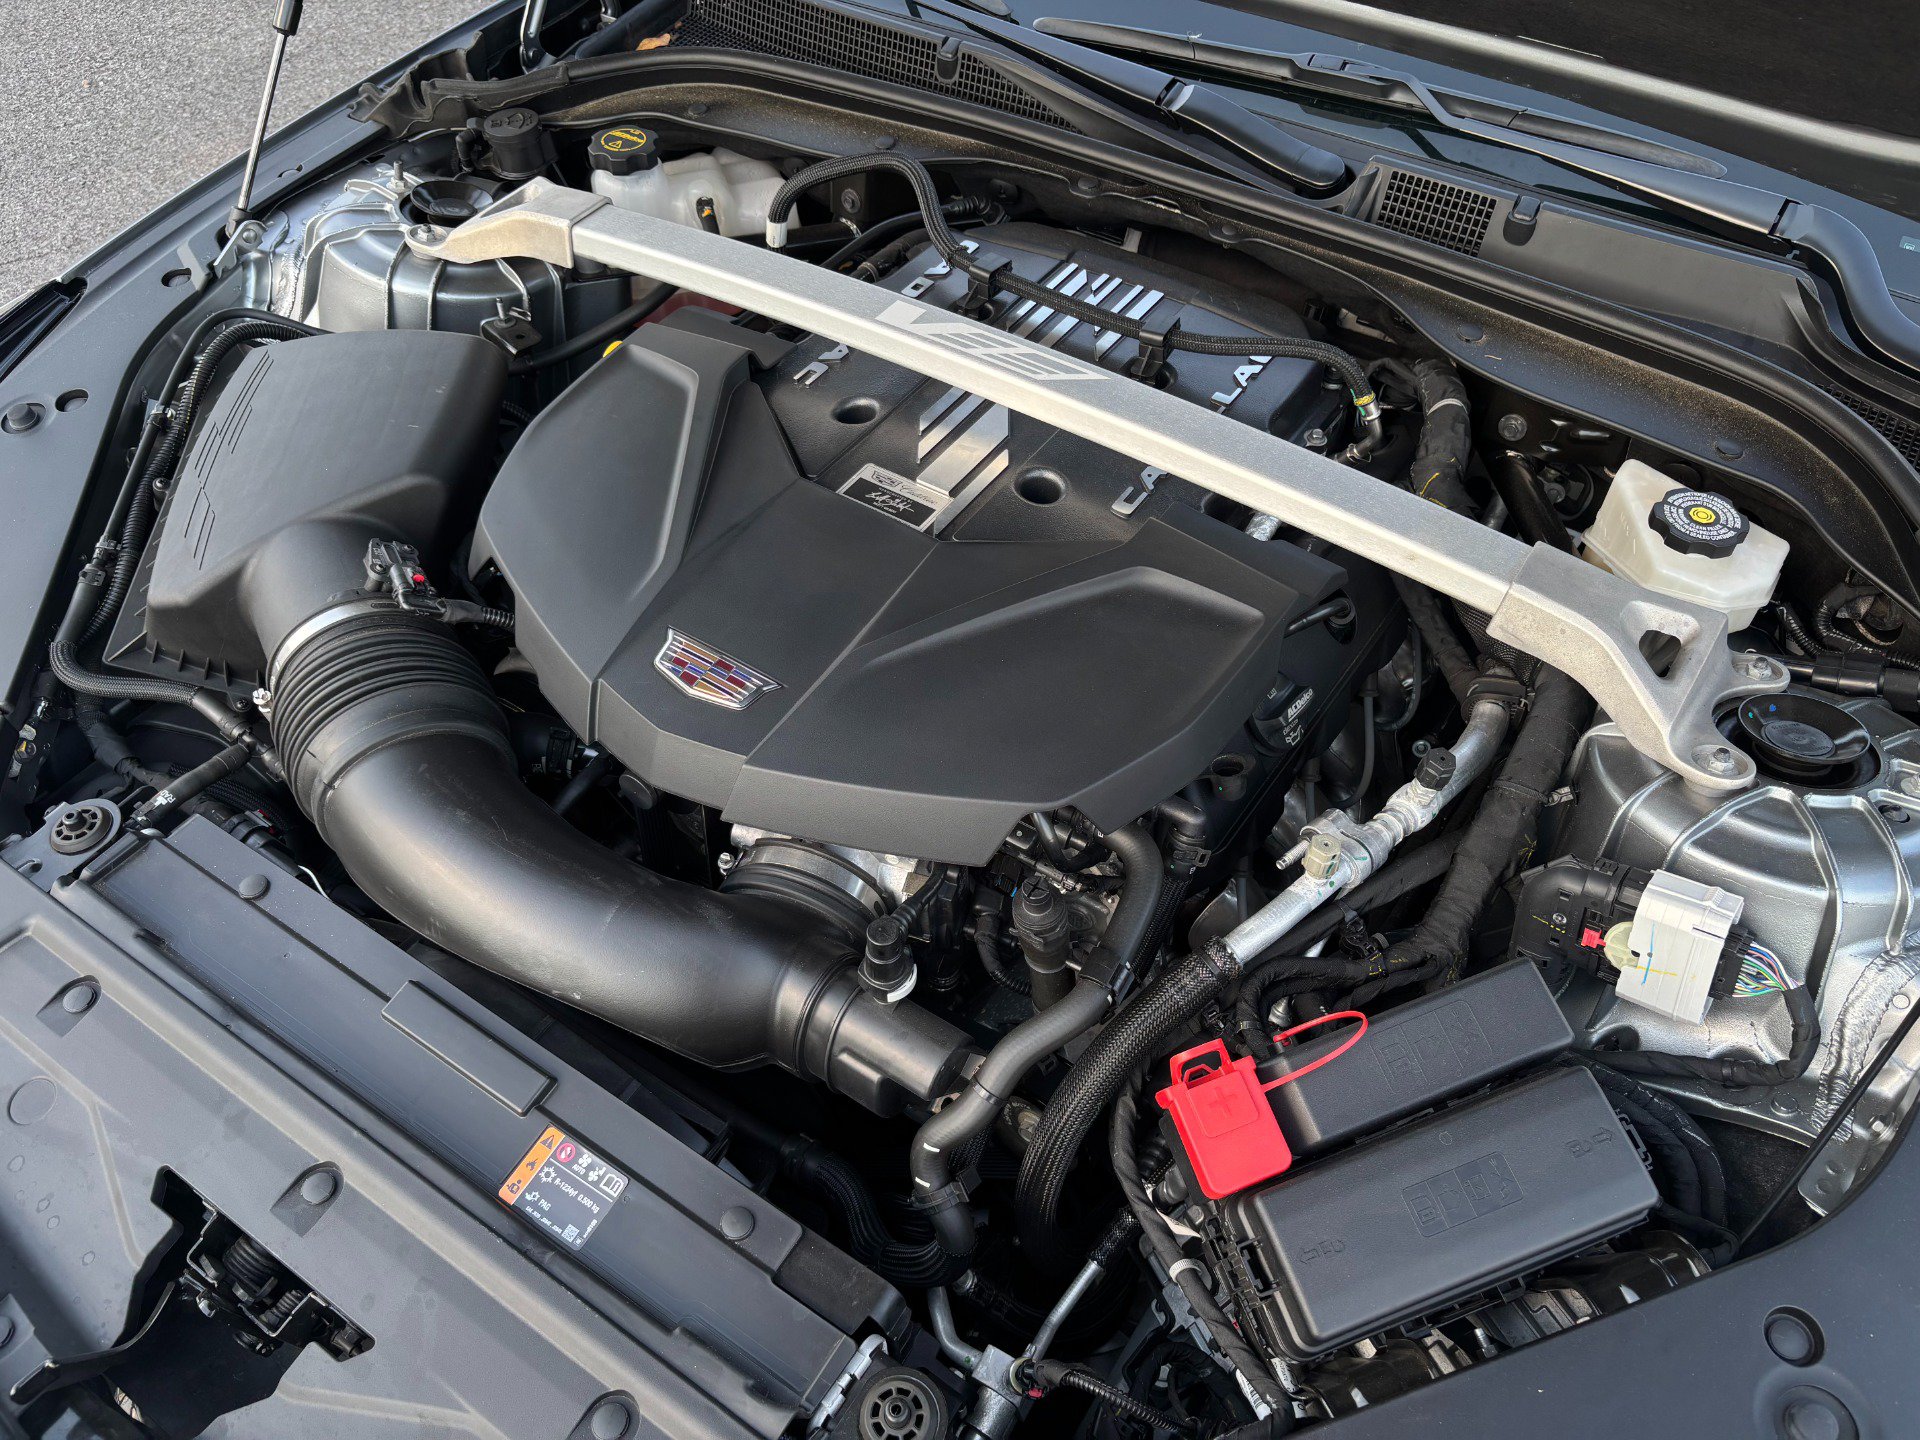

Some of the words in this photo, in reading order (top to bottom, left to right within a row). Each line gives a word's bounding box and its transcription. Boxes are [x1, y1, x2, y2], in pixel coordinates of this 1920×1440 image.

[1287, 688, 1313, 721] ACDelco
[571, 1164, 586, 1175] AUTO
[538, 1198, 552, 1211] PAG
[553, 1177, 579, 1197] R-1234yf
[591, 1203, 600, 1214] kg
